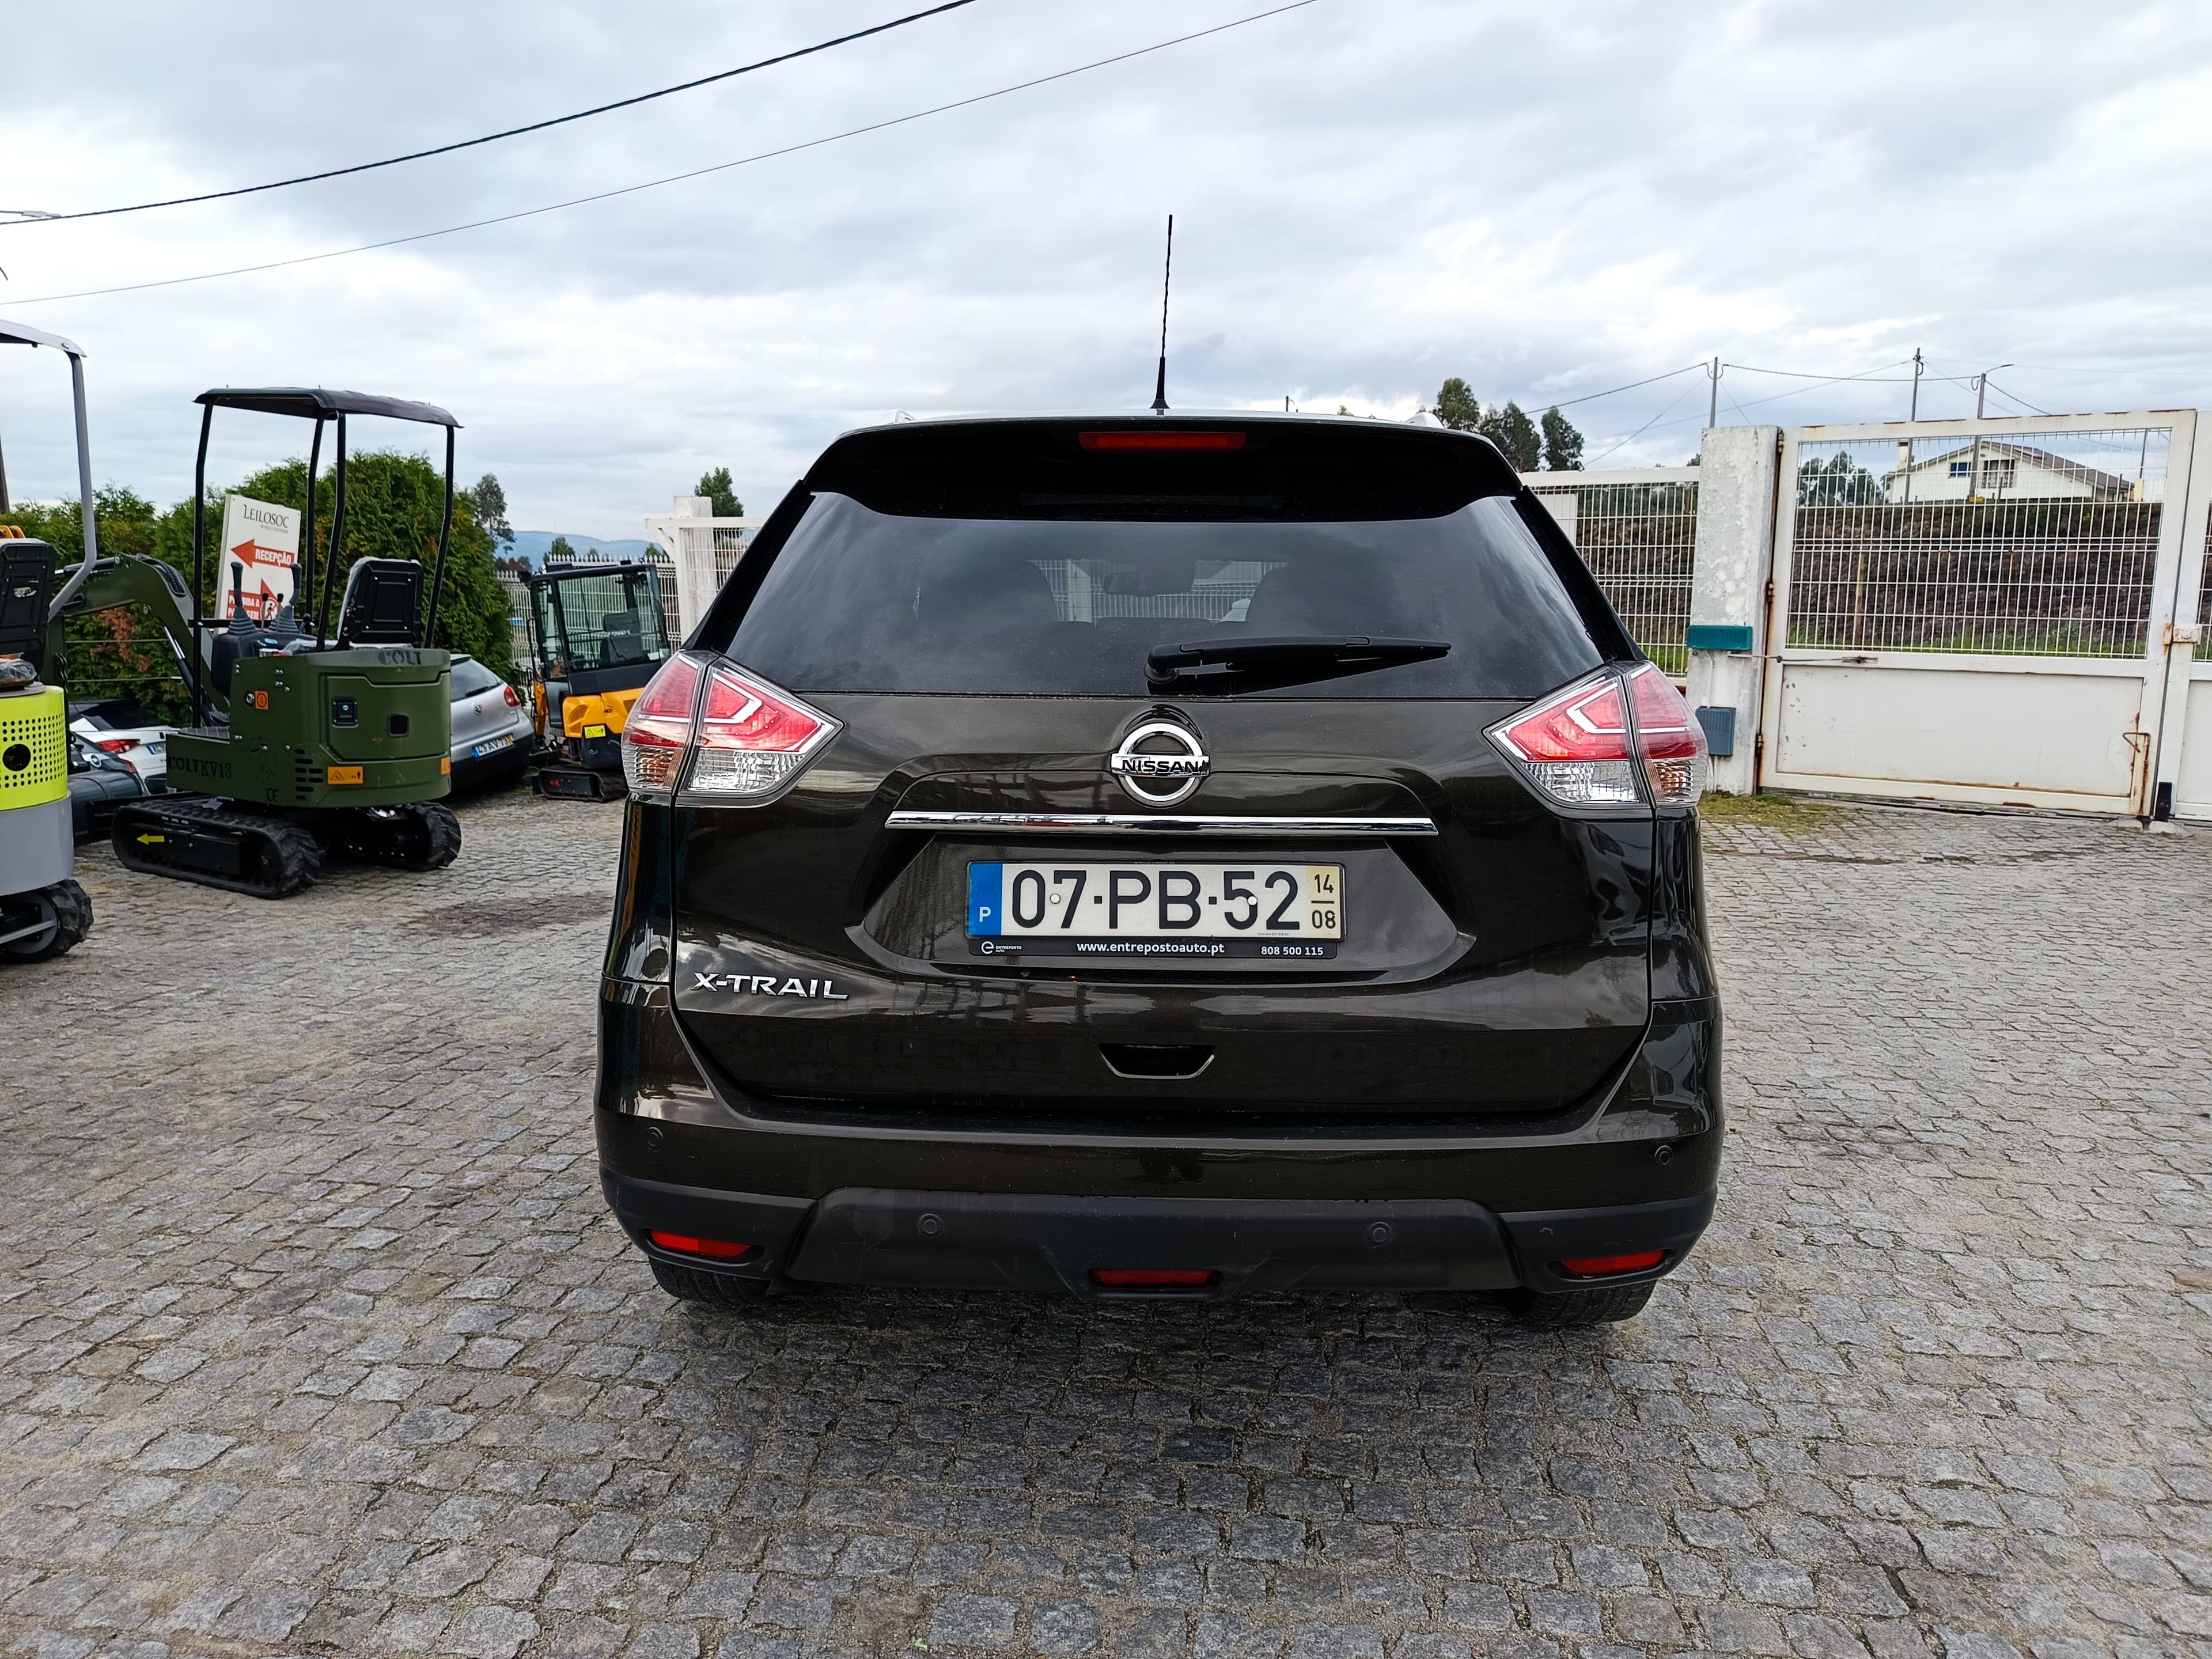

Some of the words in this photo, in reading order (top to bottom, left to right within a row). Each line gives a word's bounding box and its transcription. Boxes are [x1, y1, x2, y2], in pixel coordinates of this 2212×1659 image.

[244, 504, 289, 528] LEILOSOC
[255, 548, 291, 567] RECEPÇÃO
[378, 650, 421, 665] COLT
[1123, 759, 1198, 773] NISSAN
[1314, 874, 1334, 894] 14
[979, 906, 991, 922] P
[1311, 910, 1336, 930] 08
[1077, 941, 1225, 956] www.entrepostoauto.pt
[1260, 946, 1281, 955] 808
[1282, 946, 1302, 956] 500
[1304, 946, 1323, 956] 115
[691, 972, 849, 999] X-TRAIL
